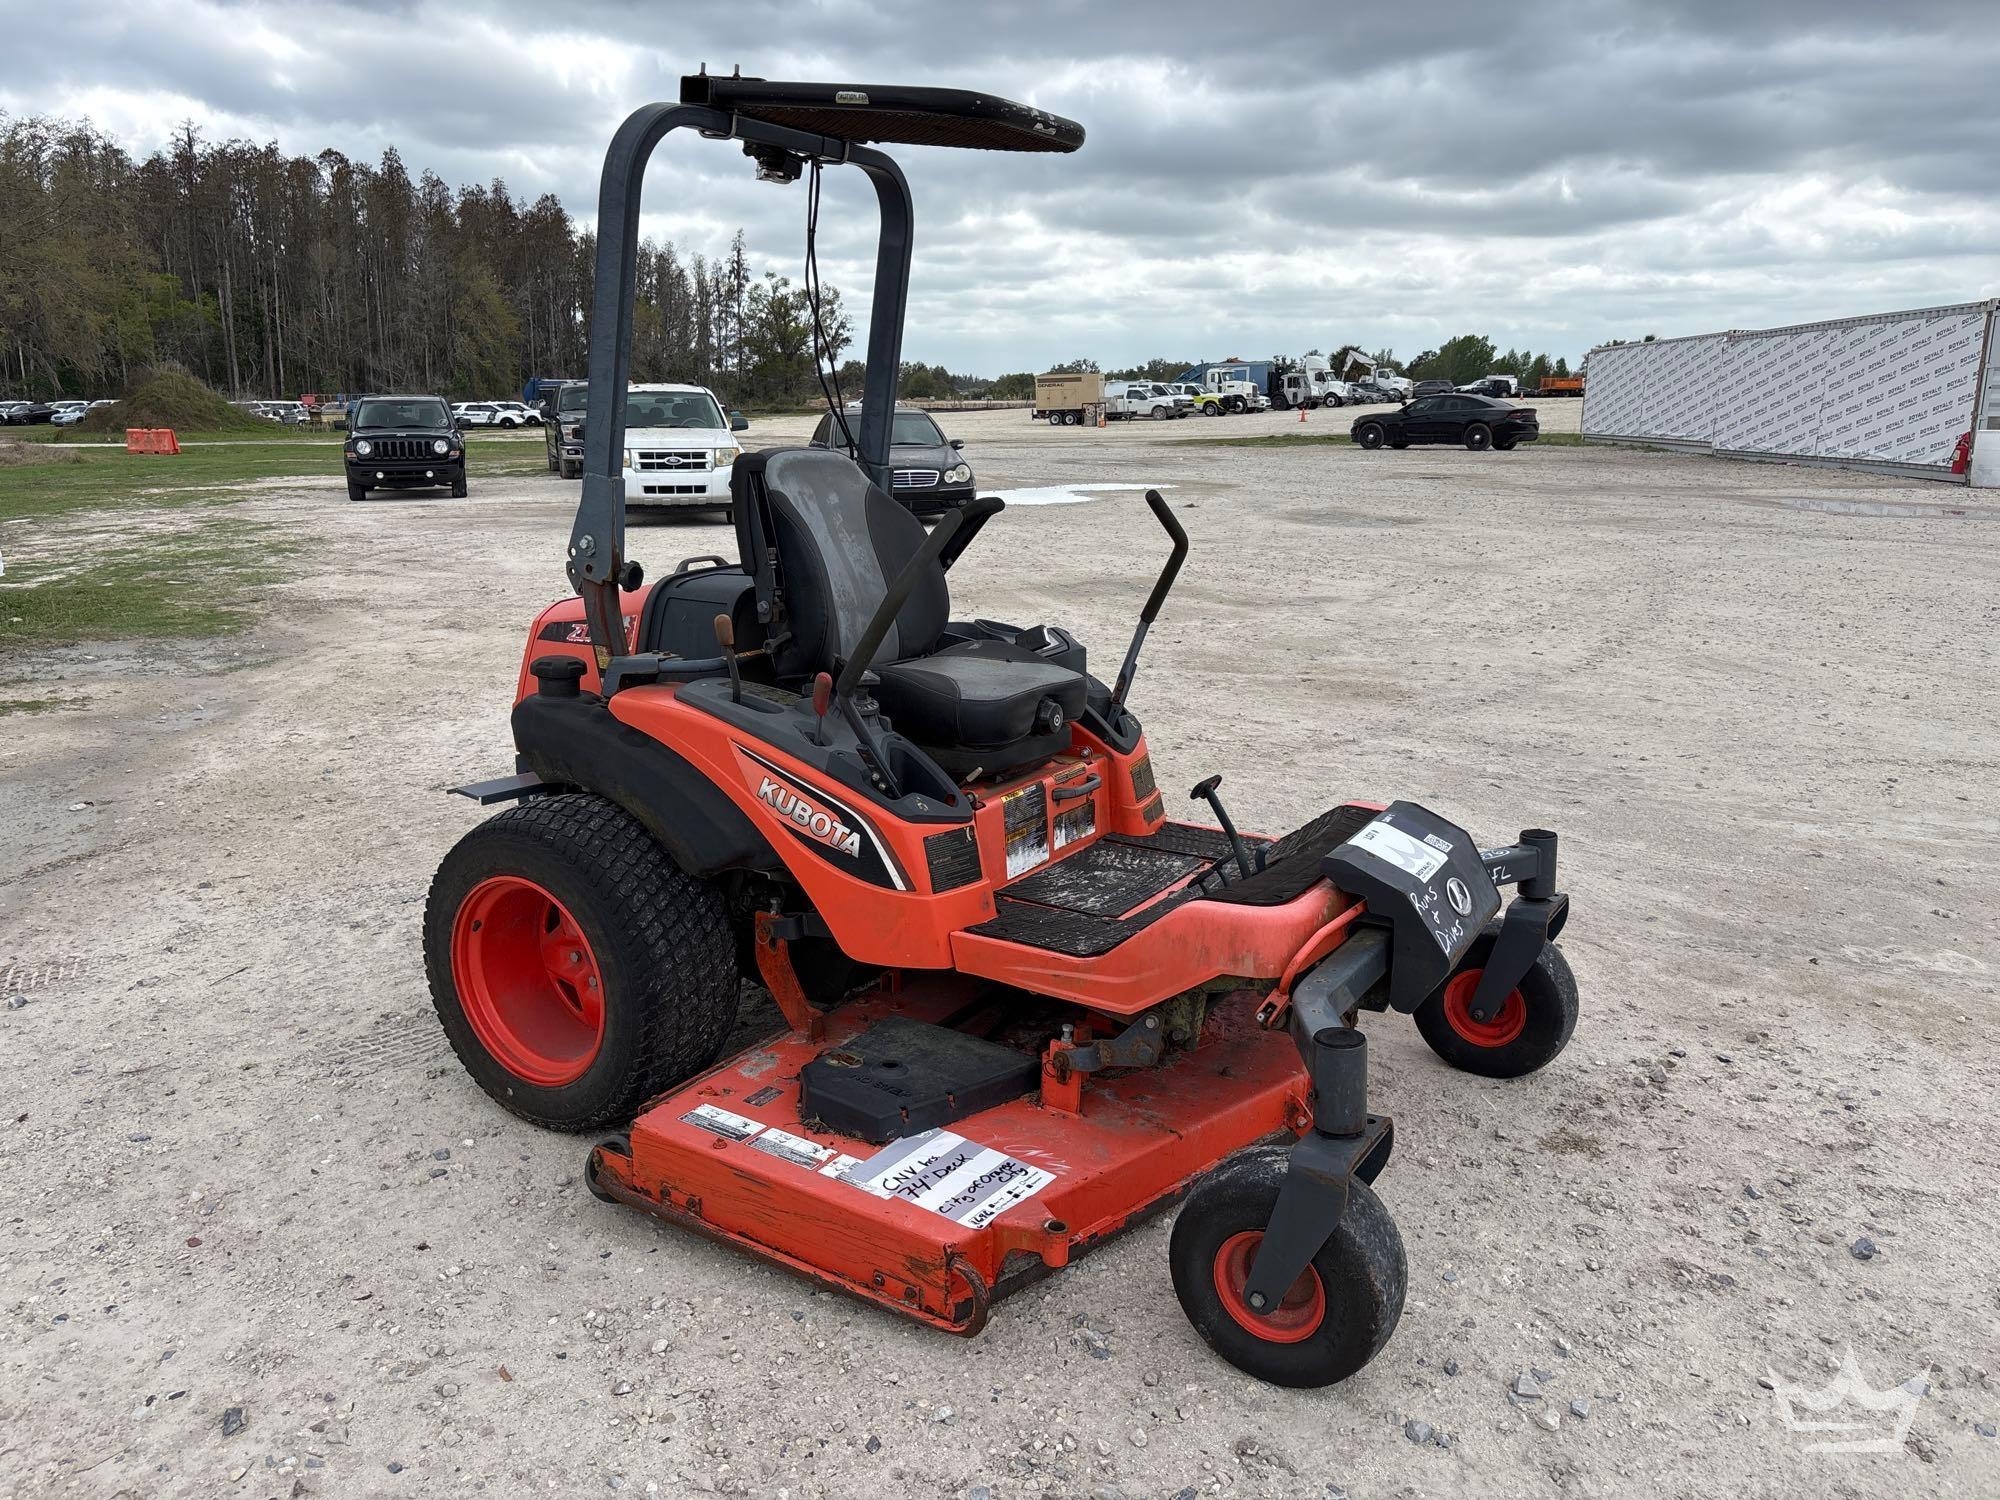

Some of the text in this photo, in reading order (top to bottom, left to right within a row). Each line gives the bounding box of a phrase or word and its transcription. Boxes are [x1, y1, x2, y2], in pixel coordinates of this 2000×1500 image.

[1902, 326, 1916, 335] ROYAL
[1936, 326, 1952, 337] ROYAL
[1880, 337, 1894, 347] ROYAL
[1911, 338, 1927, 349] ROYAL
[1948, 338, 1965, 350] ROYAL
[1890, 350, 1904, 359] ROYAL
[1924, 351, 1939, 361] ROYAL
[1960, 353, 1976, 363] ROYAL
[1901, 362, 1915, 372] ROYAL
[1934, 365, 1949, 374] ROYAL
[1879, 373, 1892, 381] ROYAL
[1911, 375, 1925, 384] ROYAL
[1947, 378, 1963, 387] ROYAL
[1888, 386, 1902, 394] ROYAL
[1922, 388, 1937, 397] ROYAL
[1899, 399, 1912, 407] ROYAL
[1932, 403, 1947, 411] ROYAL
[1877, 408, 1890, 416] ROYAL
[1909, 412, 1922, 420] ROYAL
[1886, 421, 1900, 429] ROYAL
[1945, 417, 1960, 425] ROYAL
[1919, 426, 1934, 434] ROYAL
[1897, 435, 1910, 443] ROYAL
[1875, 442, 1888, 450] ROYAL
[1930, 440, 1945, 449] ROYAL
[1906, 449, 1920, 457] ROYAL
[757, 777, 861, 859] KUBOTA
[1492, 866, 1512, 884] FL
[1410, 886, 1438, 916] Runs
